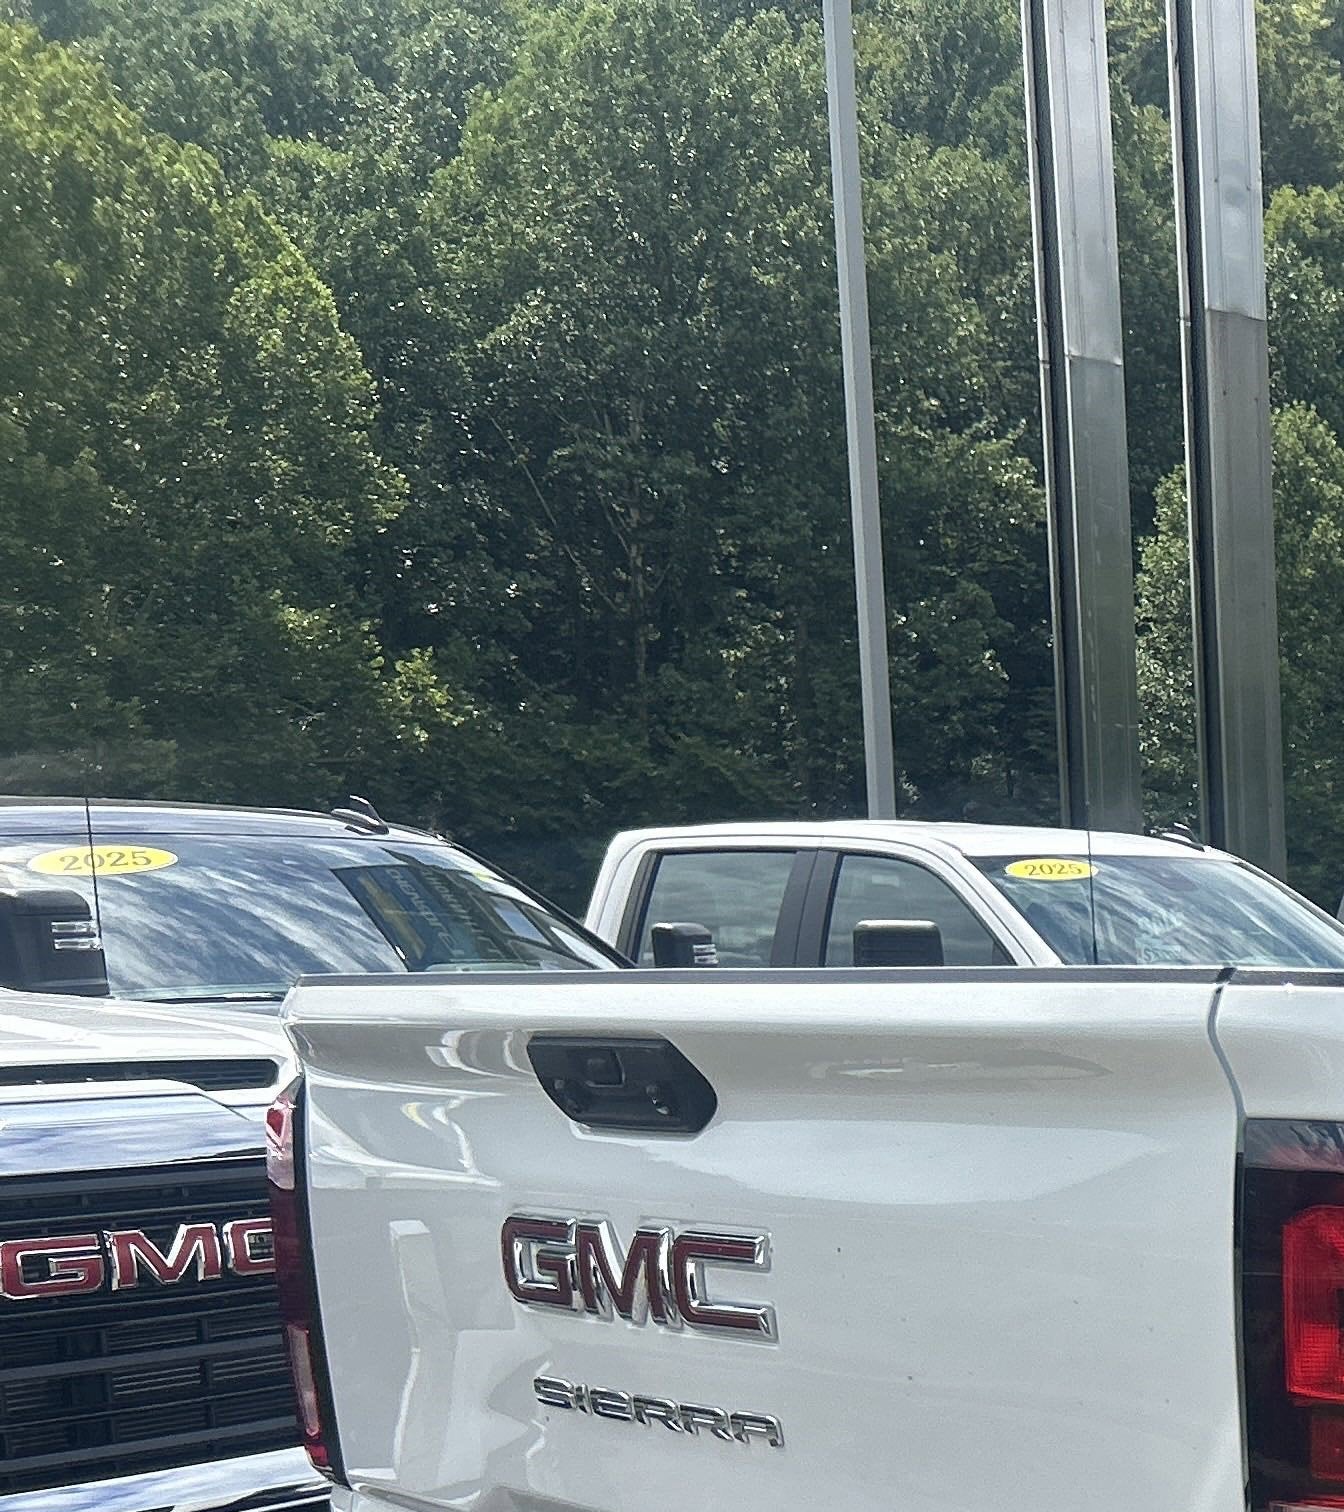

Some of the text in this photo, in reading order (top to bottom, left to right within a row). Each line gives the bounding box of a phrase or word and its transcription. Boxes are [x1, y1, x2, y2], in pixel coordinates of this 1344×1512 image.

[59, 851, 152, 871] 2025
[1024, 863, 1082, 876] 2025
[501, 1207, 781, 1347] GMC
[533, 1375, 785, 1449] SIERRA
